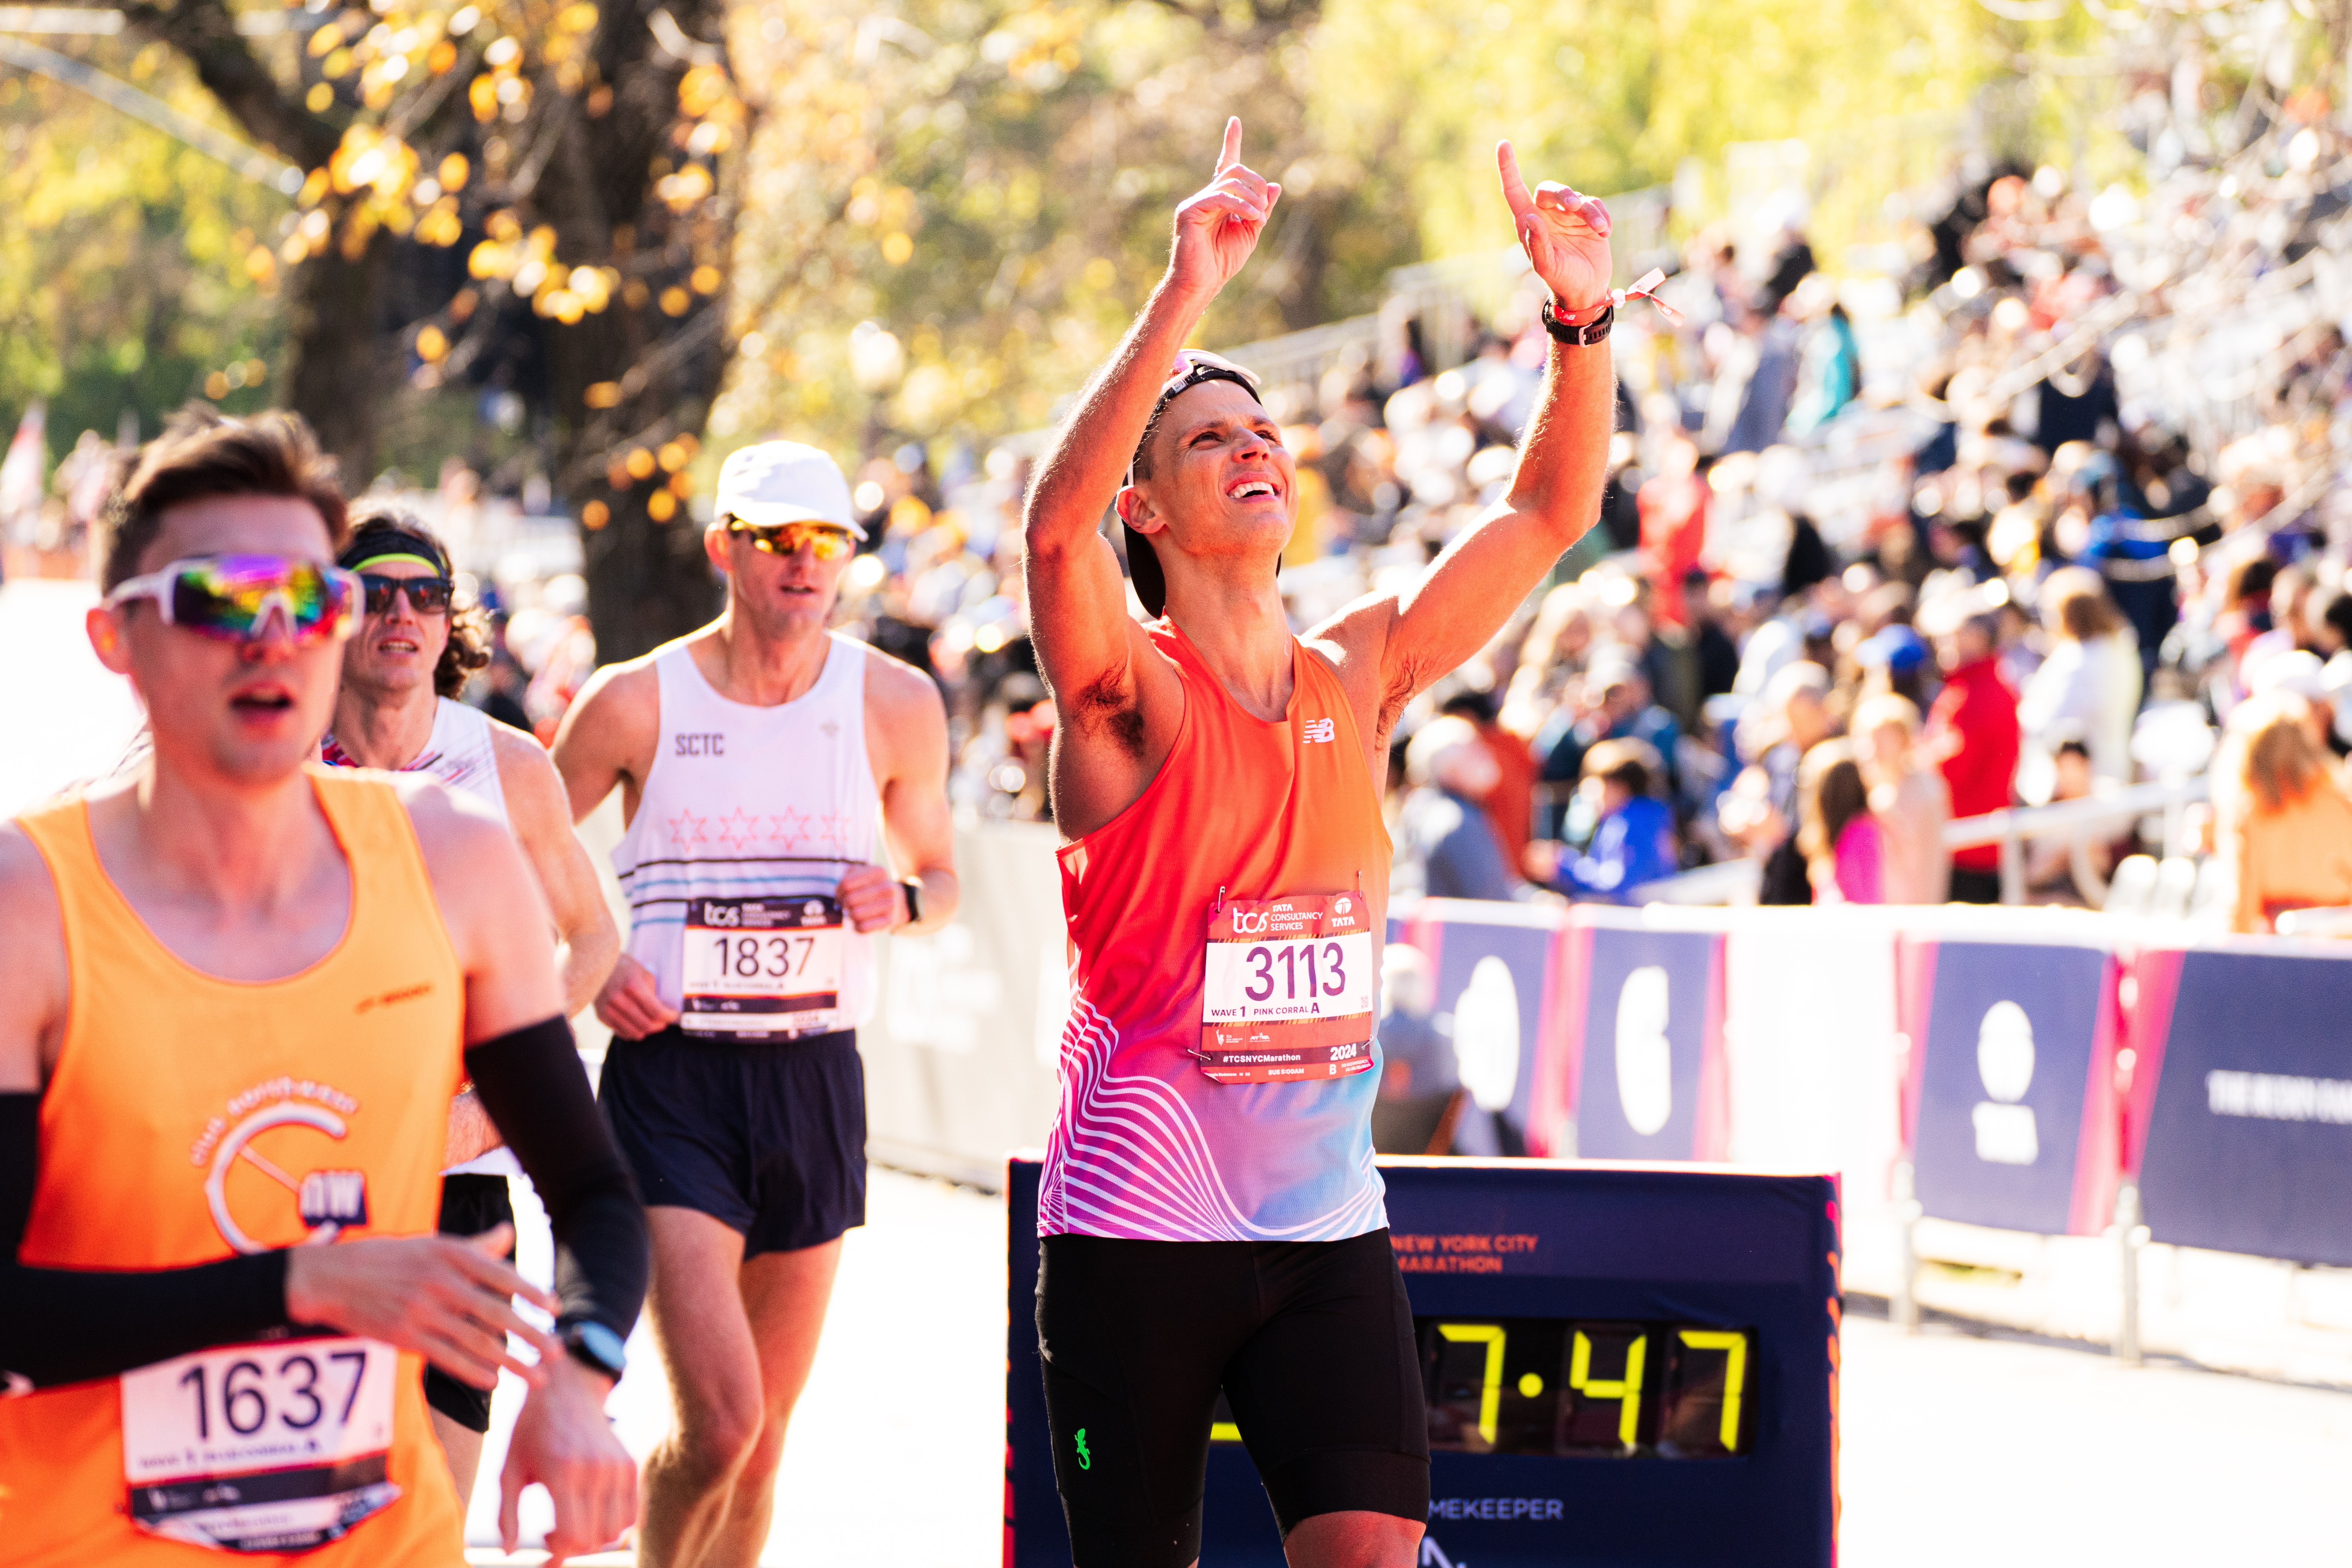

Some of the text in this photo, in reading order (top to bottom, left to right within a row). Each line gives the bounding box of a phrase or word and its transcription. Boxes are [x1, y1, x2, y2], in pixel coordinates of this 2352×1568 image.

[675, 732, 724, 756] SCTC
[704, 902, 740, 926] tcs
[1233, 907, 1269, 934] tcs
[1271, 912, 1323, 921] CONSULTANCY
[1332, 916, 1355, 927] TATA
[1270, 922, 1303, 931] SERVICES
[715, 937, 815, 977] 1837
[1245, 942, 1345, 1001] 3113
[1240, 1006, 1245, 1017] 1
[1311, 1002, 1320, 1014] A
[1223, 1054, 1301, 1063] #TCSNYCMarathon
[1330, 1043, 1357, 1061] 2024
[1329, 1064, 1336, 1075] B
[1439, 1234, 1491, 1252] YORK
[1494, 1234, 1538, 1252] CITY
[180, 1350, 367, 1443] 1637
